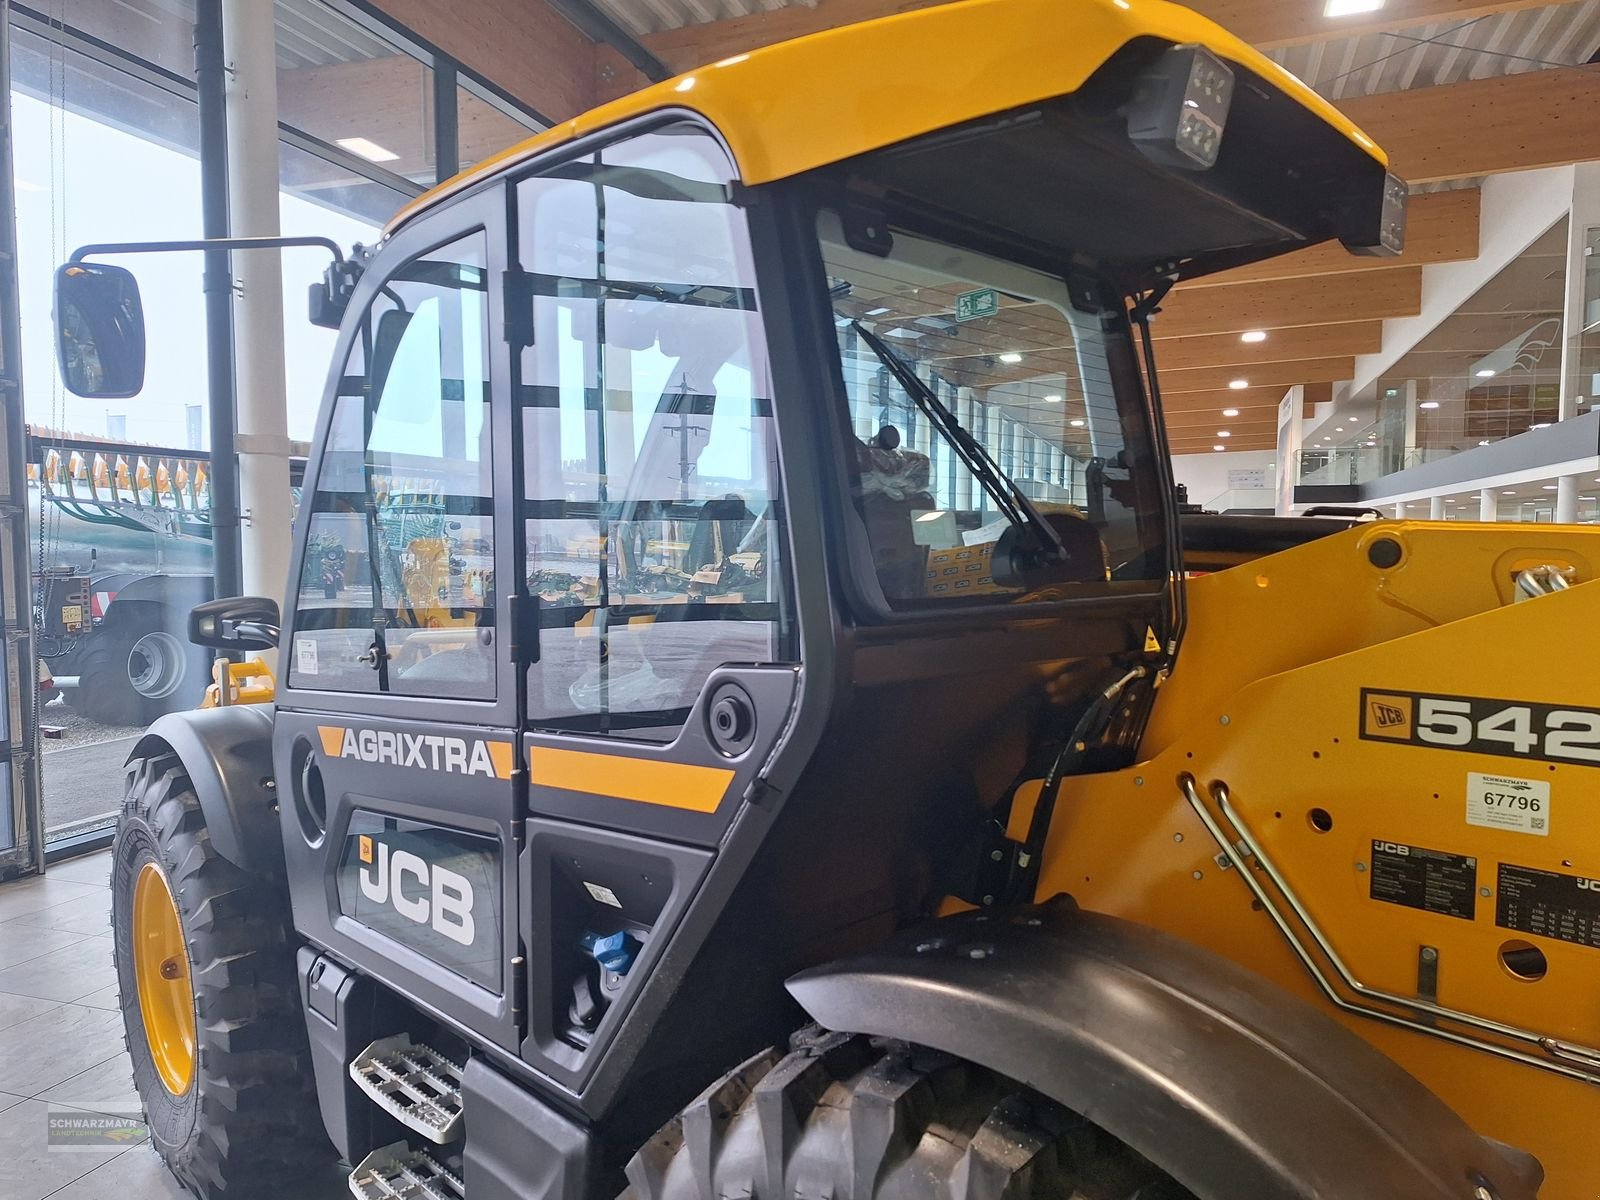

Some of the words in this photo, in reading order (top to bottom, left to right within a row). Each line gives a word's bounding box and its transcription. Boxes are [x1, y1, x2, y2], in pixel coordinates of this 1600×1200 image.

[341, 727, 496, 778] AGRIXTRA
[1376, 705, 1404, 726] JCB
[1416, 698, 1600, 761] 542
[1484, 792, 1541, 812] 67796
[1374, 841, 1410, 856] JCB
[359, 841, 475, 946] JCB
